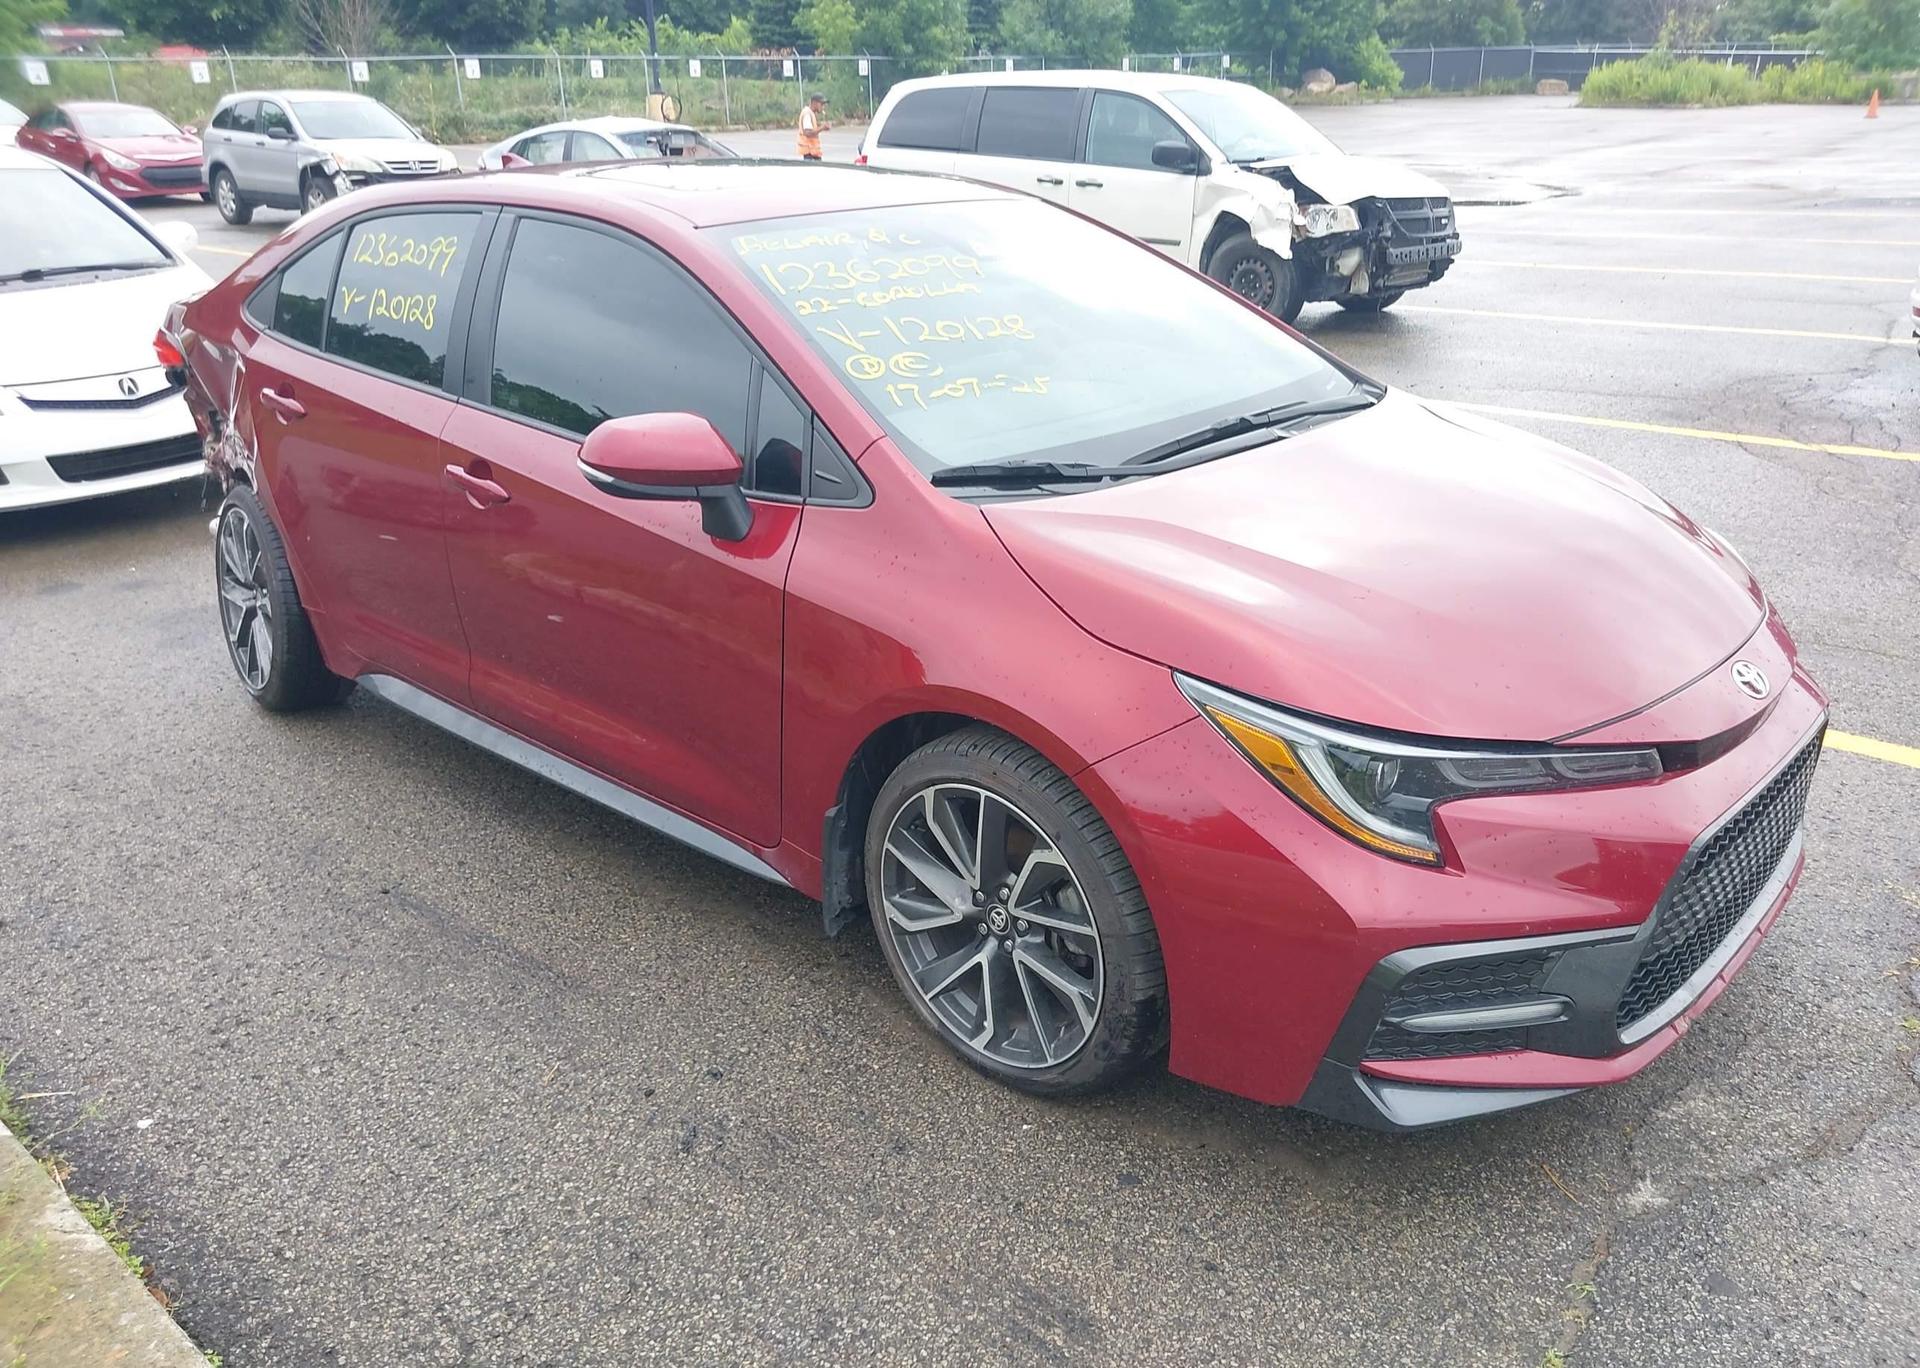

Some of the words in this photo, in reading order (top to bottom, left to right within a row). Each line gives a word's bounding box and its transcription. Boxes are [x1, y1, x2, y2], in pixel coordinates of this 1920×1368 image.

[354, 233, 457, 277] 12362099
[760, 254, 985, 295] 12362099
[816, 314, 1036, 352] V-120128
